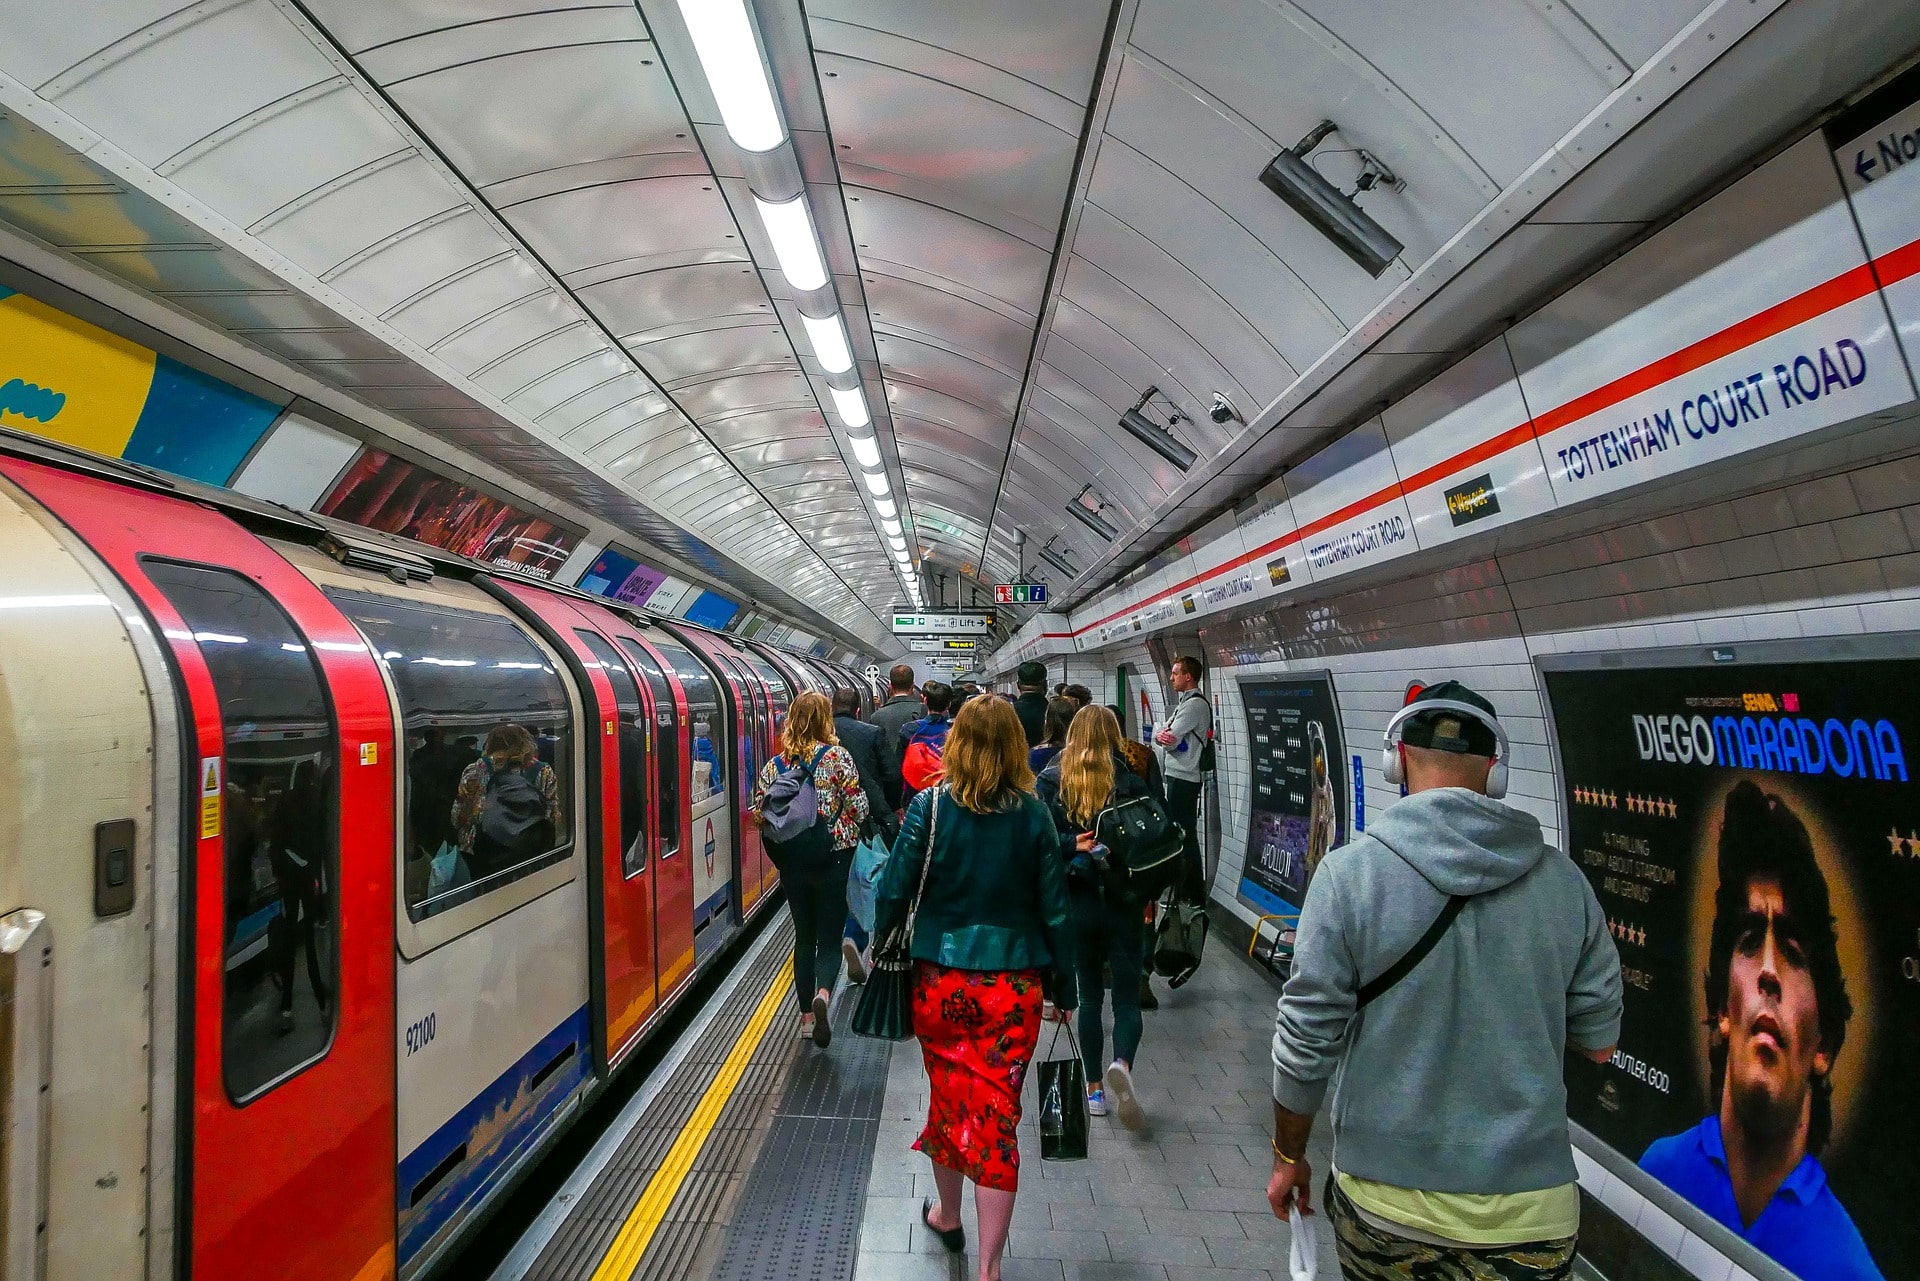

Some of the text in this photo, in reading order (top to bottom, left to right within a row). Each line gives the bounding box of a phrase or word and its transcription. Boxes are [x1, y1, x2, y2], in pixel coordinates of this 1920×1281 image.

[1557, 338, 1867, 482] TOTTENHAM COURT ROAD
[1453, 492, 1473, 514] Way
[1310, 515, 1405, 568] TOTTENHAM COURT ROAD
[492, 557, 551, 579] AMERICAN EXPRESS
[959, 619, 975, 627] Lift
[1631, 714, 1909, 782] DIEGO MARADONA
[1260, 843, 1286, 875] APOLLO
[406, 1011, 436, 1058] 92100
[1647, 1066, 1670, 1094] GOD.
